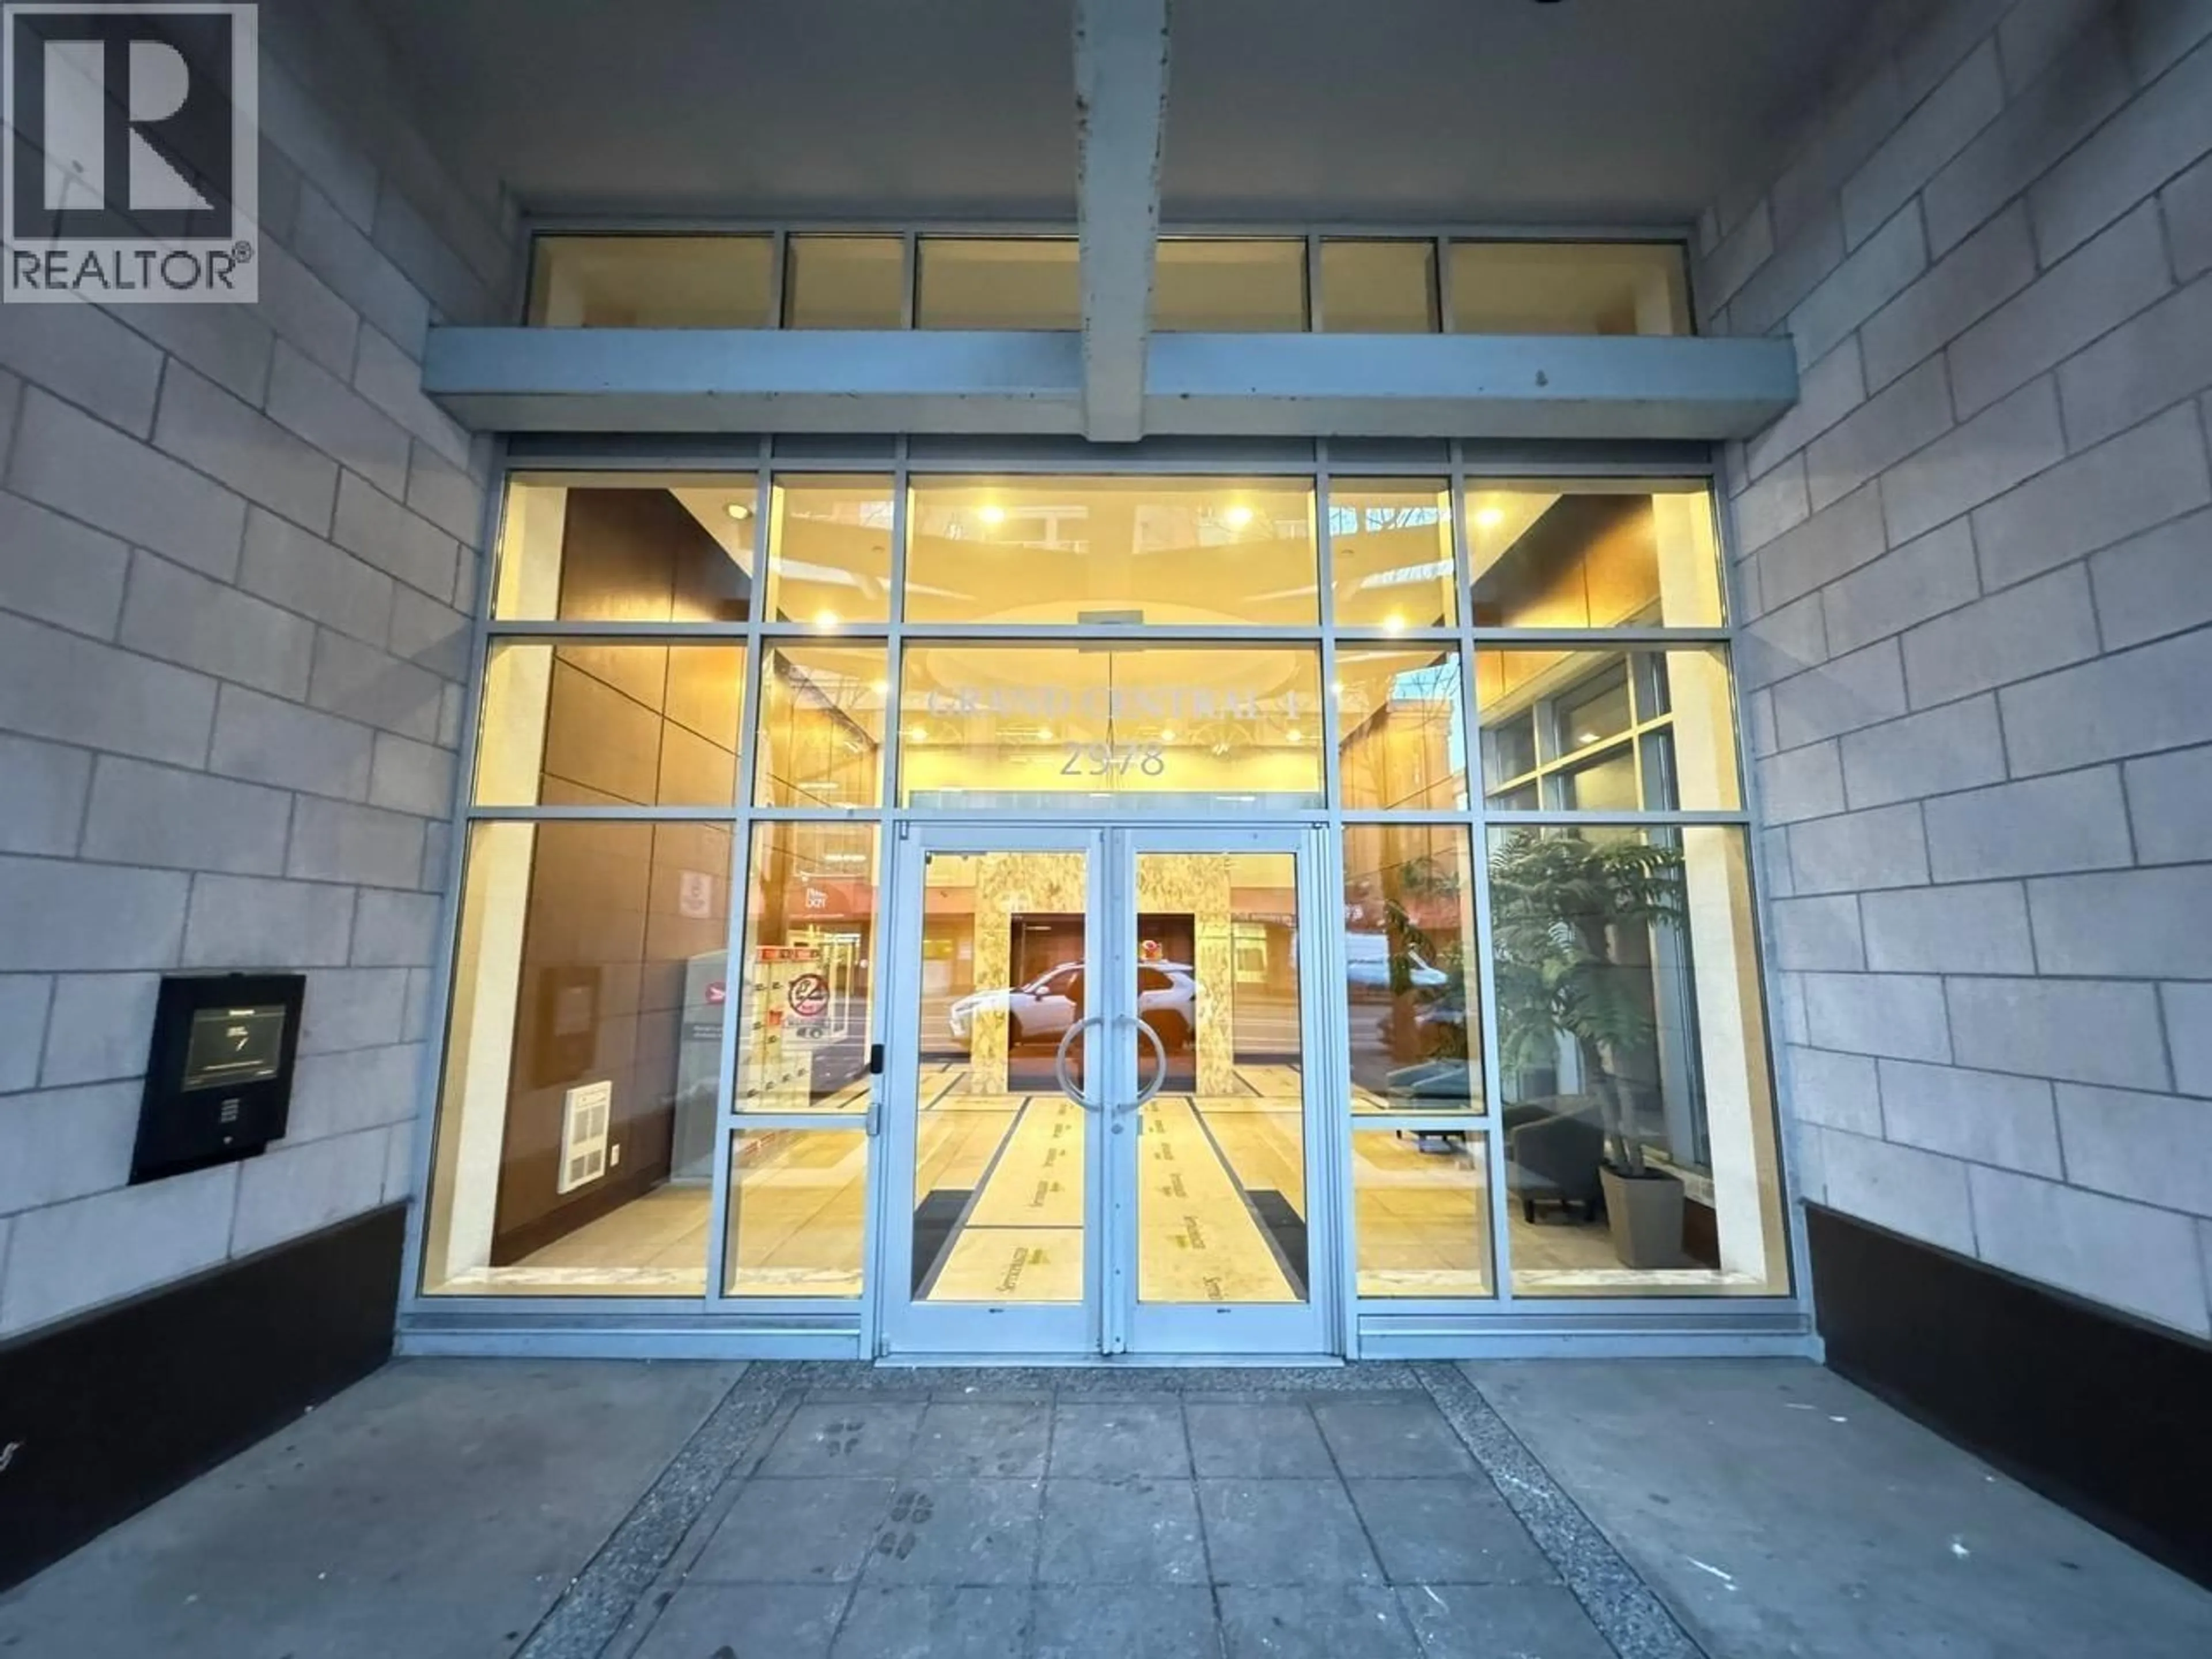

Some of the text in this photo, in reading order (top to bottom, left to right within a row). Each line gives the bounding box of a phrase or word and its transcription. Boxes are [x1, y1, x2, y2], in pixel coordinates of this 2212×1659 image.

[927, 685, 1070, 720] GRAND
[1077, 685, 1259, 720] CENTRAL
[1060, 741, 1165, 776] 2978
